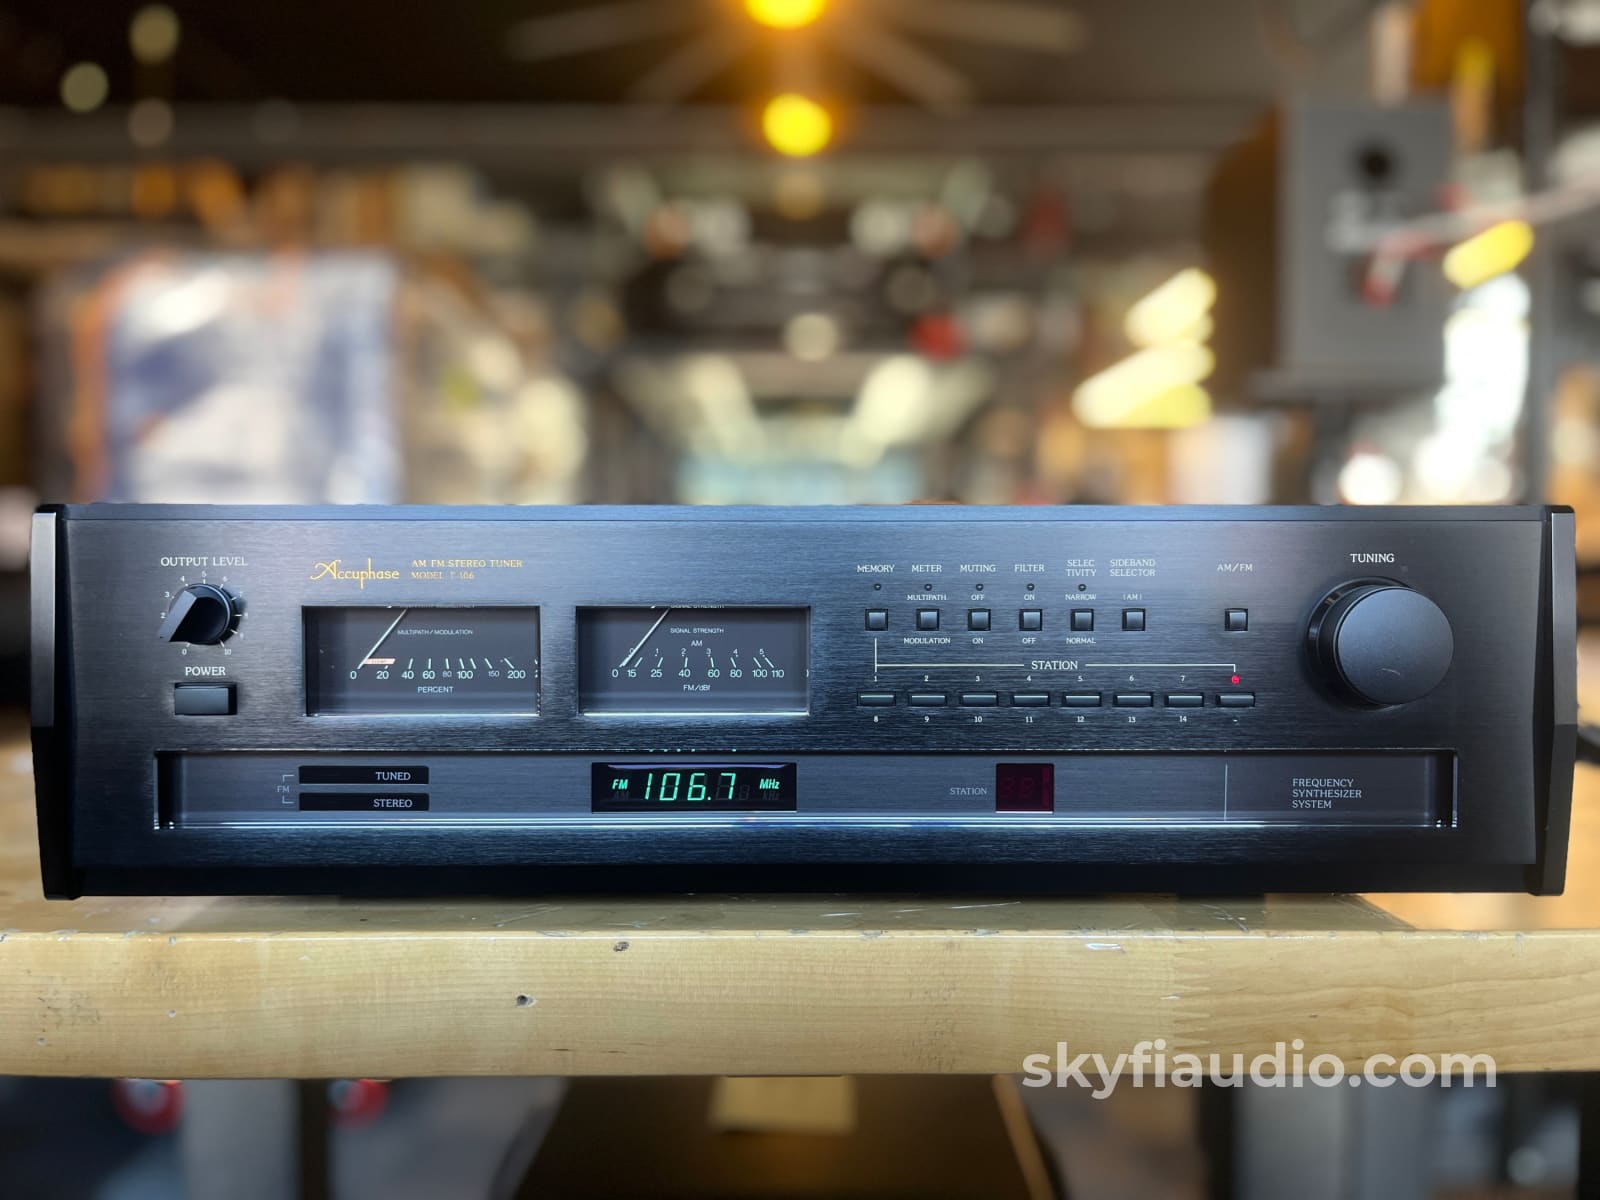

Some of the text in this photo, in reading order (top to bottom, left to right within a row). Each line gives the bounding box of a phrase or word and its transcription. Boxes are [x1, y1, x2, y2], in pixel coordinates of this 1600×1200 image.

[160, 556, 248, 567] OUTPUT LEVEL
[1350, 553, 1395, 563] TUNING
[447, 560, 487, 568] STEREO
[490, 560, 523, 568] TUNER
[1067, 559, 1095, 567] SELEC
[1110, 559, 1155, 567] SIDEBAND
[1217, 563, 1253, 572] AM/FM
[857, 564, 895, 573] MEMORY
[911, 564, 942, 573] METER
[960, 564, 996, 573] MUTING
[1014, 564, 1045, 573] FILTER
[1066, 568, 1097, 577] TIVITY
[1109, 568, 1156, 577] SELECTOR
[310, 558, 399, 590] Accuphase
[411, 571, 442, 579] MODEL
[1031, 660, 1078, 670] STATION
[185, 666, 226, 676] POWER
[350, 670, 357, 680] 0
[376, 670, 390, 680] 20
[401, 670, 414, 680] 40
[422, 670, 435, 680] 60
[457, 670, 473, 680] 100
[488, 670, 500, 678] 150
[506, 670, 526, 680] 200
[612, 669, 785, 678] 0 15 25 40 60 80 100 110
[974, 715, 982, 723] 10
[1025, 715, 1033, 723] 11
[1077, 715, 1085, 723] 12
[1179, 715, 1187, 723] 14
[376, 771, 411, 781] TUNED
[612, 773, 780, 801] FM 106.7 MHz
[1292, 778, 1354, 788] FREQUENCY
[277, 785, 290, 793] FM
[949, 787, 987, 795] STATION
[1292, 789, 1362, 798] SYNTHESIZER
[373, 799, 413, 808] STEREO
[1292, 800, 1332, 809] SYSTEM
